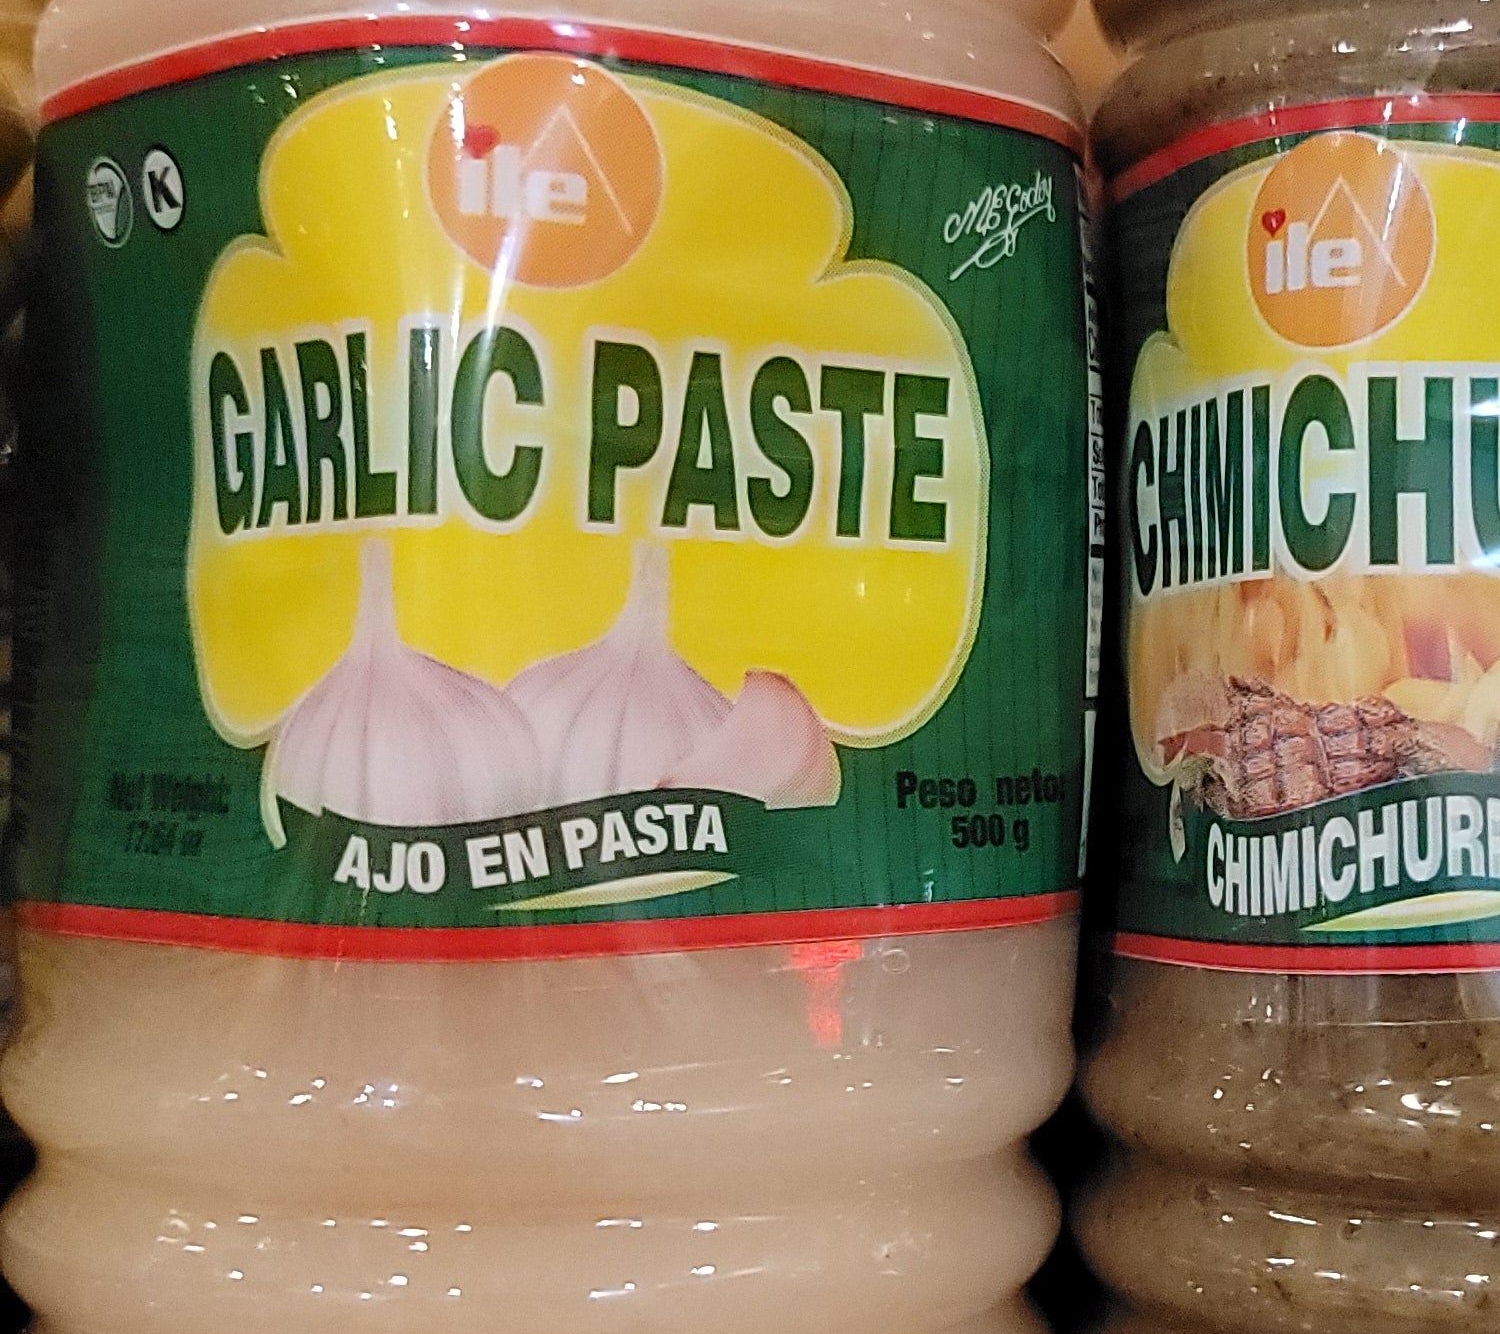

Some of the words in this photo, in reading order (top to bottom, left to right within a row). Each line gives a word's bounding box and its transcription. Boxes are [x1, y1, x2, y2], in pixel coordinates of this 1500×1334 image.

[456, 124, 588, 223] ile
[1262, 208, 1362, 295] ile
[209, 325, 545, 535] GARLIC
[587, 339, 951, 543] PASTE
[897, 771, 977, 810] Peso
[952, 814, 1006, 848] 500
[1013, 817, 1030, 852] g
[334, 836, 446, 894] AJO
[467, 827, 550, 890] EN
[561, 804, 728, 871] PASTA
